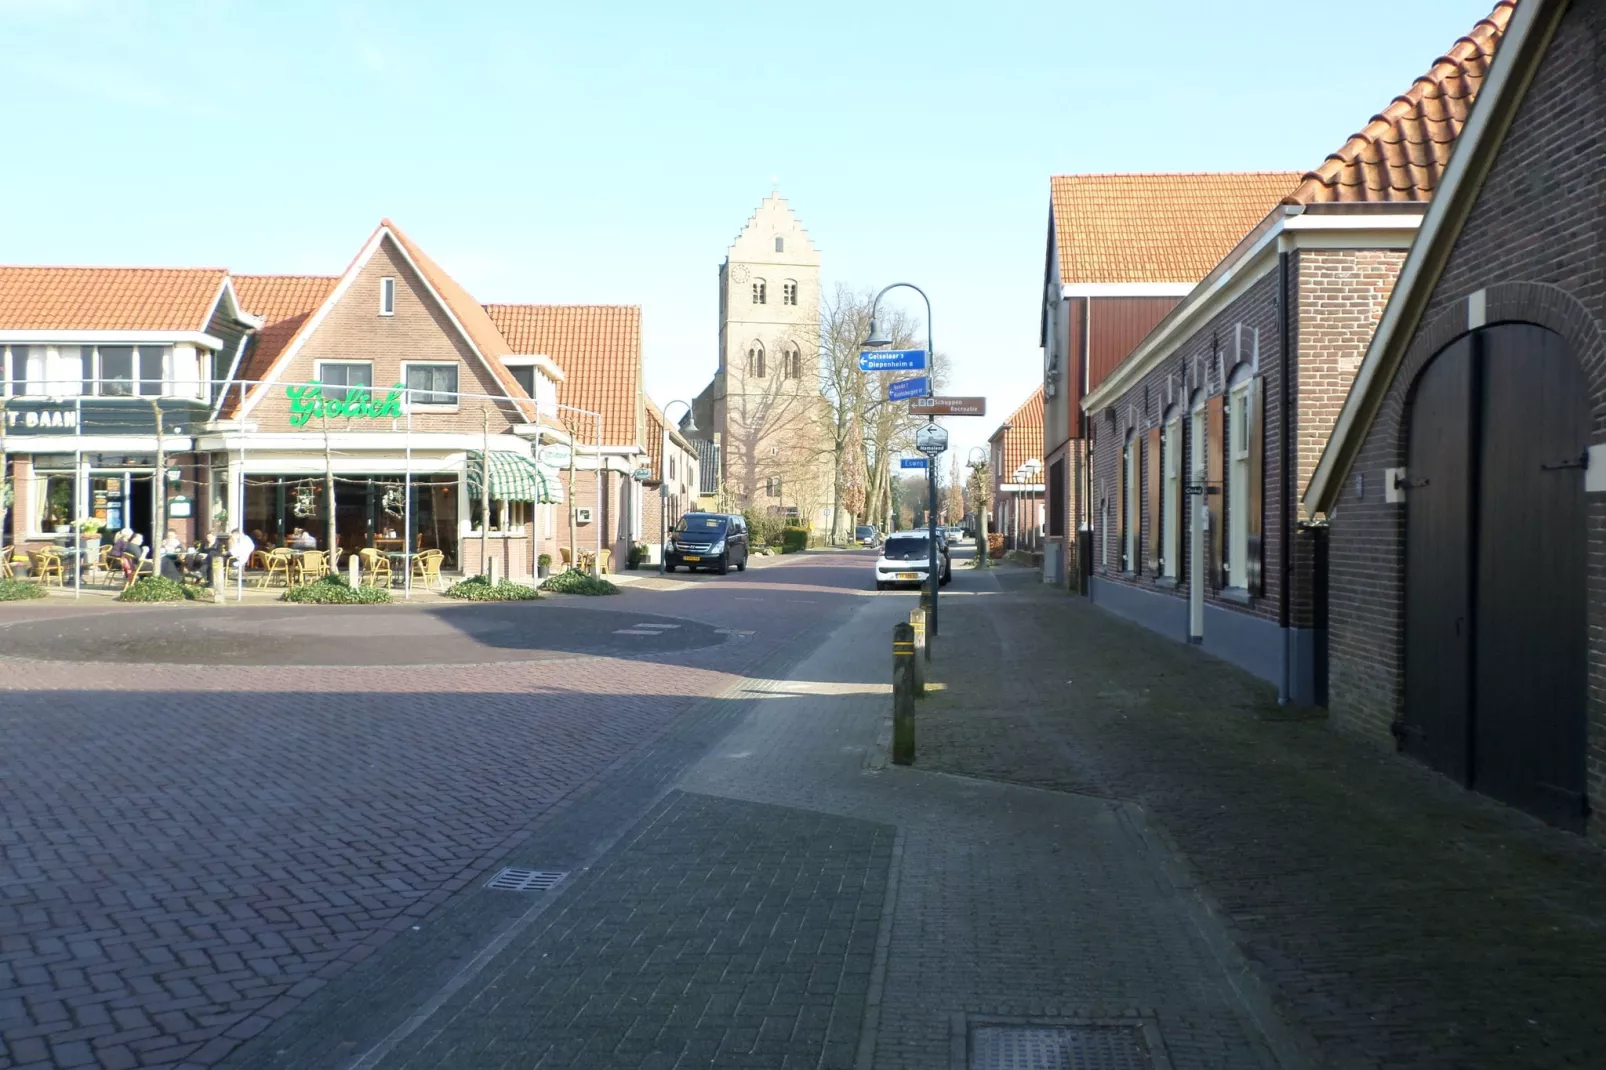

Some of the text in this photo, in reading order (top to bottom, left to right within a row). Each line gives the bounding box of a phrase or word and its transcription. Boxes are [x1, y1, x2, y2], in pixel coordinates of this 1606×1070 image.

[868, 361, 908, 369] Diepenheim
[286, 379, 406, 427] Grolsch
[26, 410, 76, 428] BAAN
